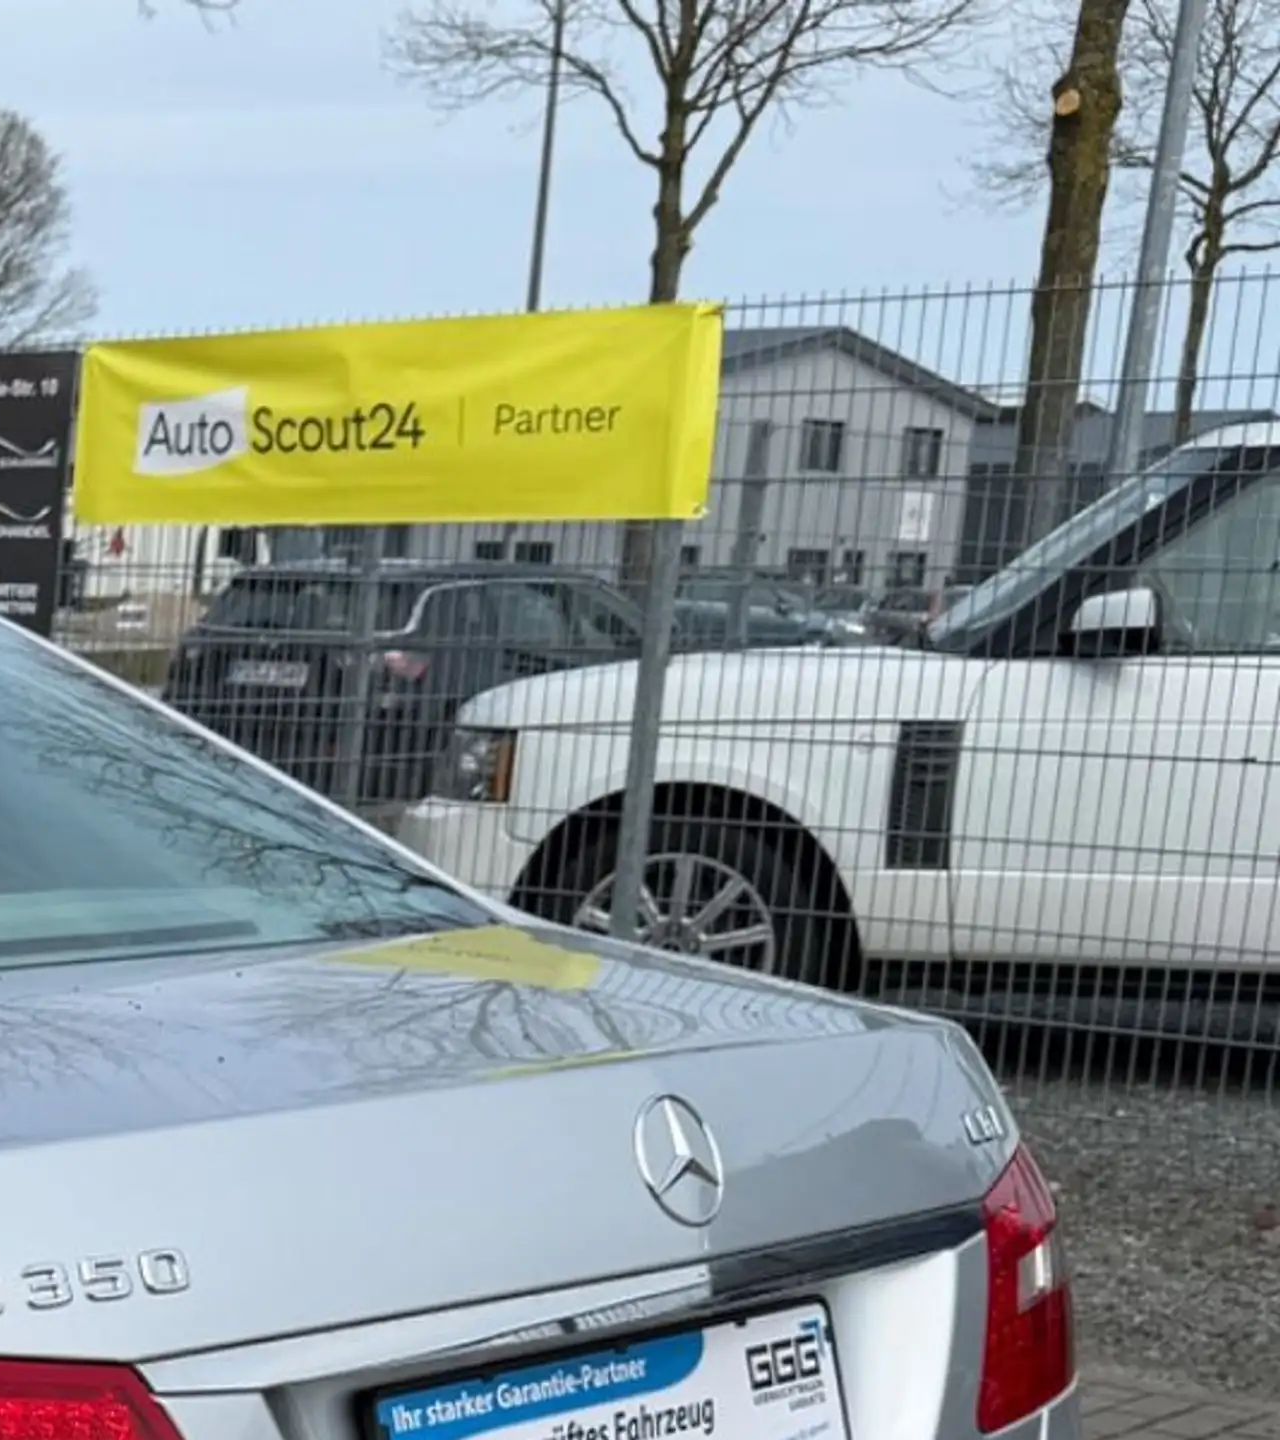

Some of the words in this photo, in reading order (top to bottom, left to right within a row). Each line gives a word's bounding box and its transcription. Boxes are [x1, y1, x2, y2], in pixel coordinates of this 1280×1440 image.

[142, 409, 235, 456] Auto
[251, 401, 426, 455] Scout24
[493, 401, 621, 437] Partner
[20, 1248, 192, 1311] 350
[745, 1333, 822, 1391] GGG
[391, 1405, 422, 1433] Ihr
[426, 1389, 494, 1425] starker
[496, 1357, 648, 1408] Garantie-Partner
